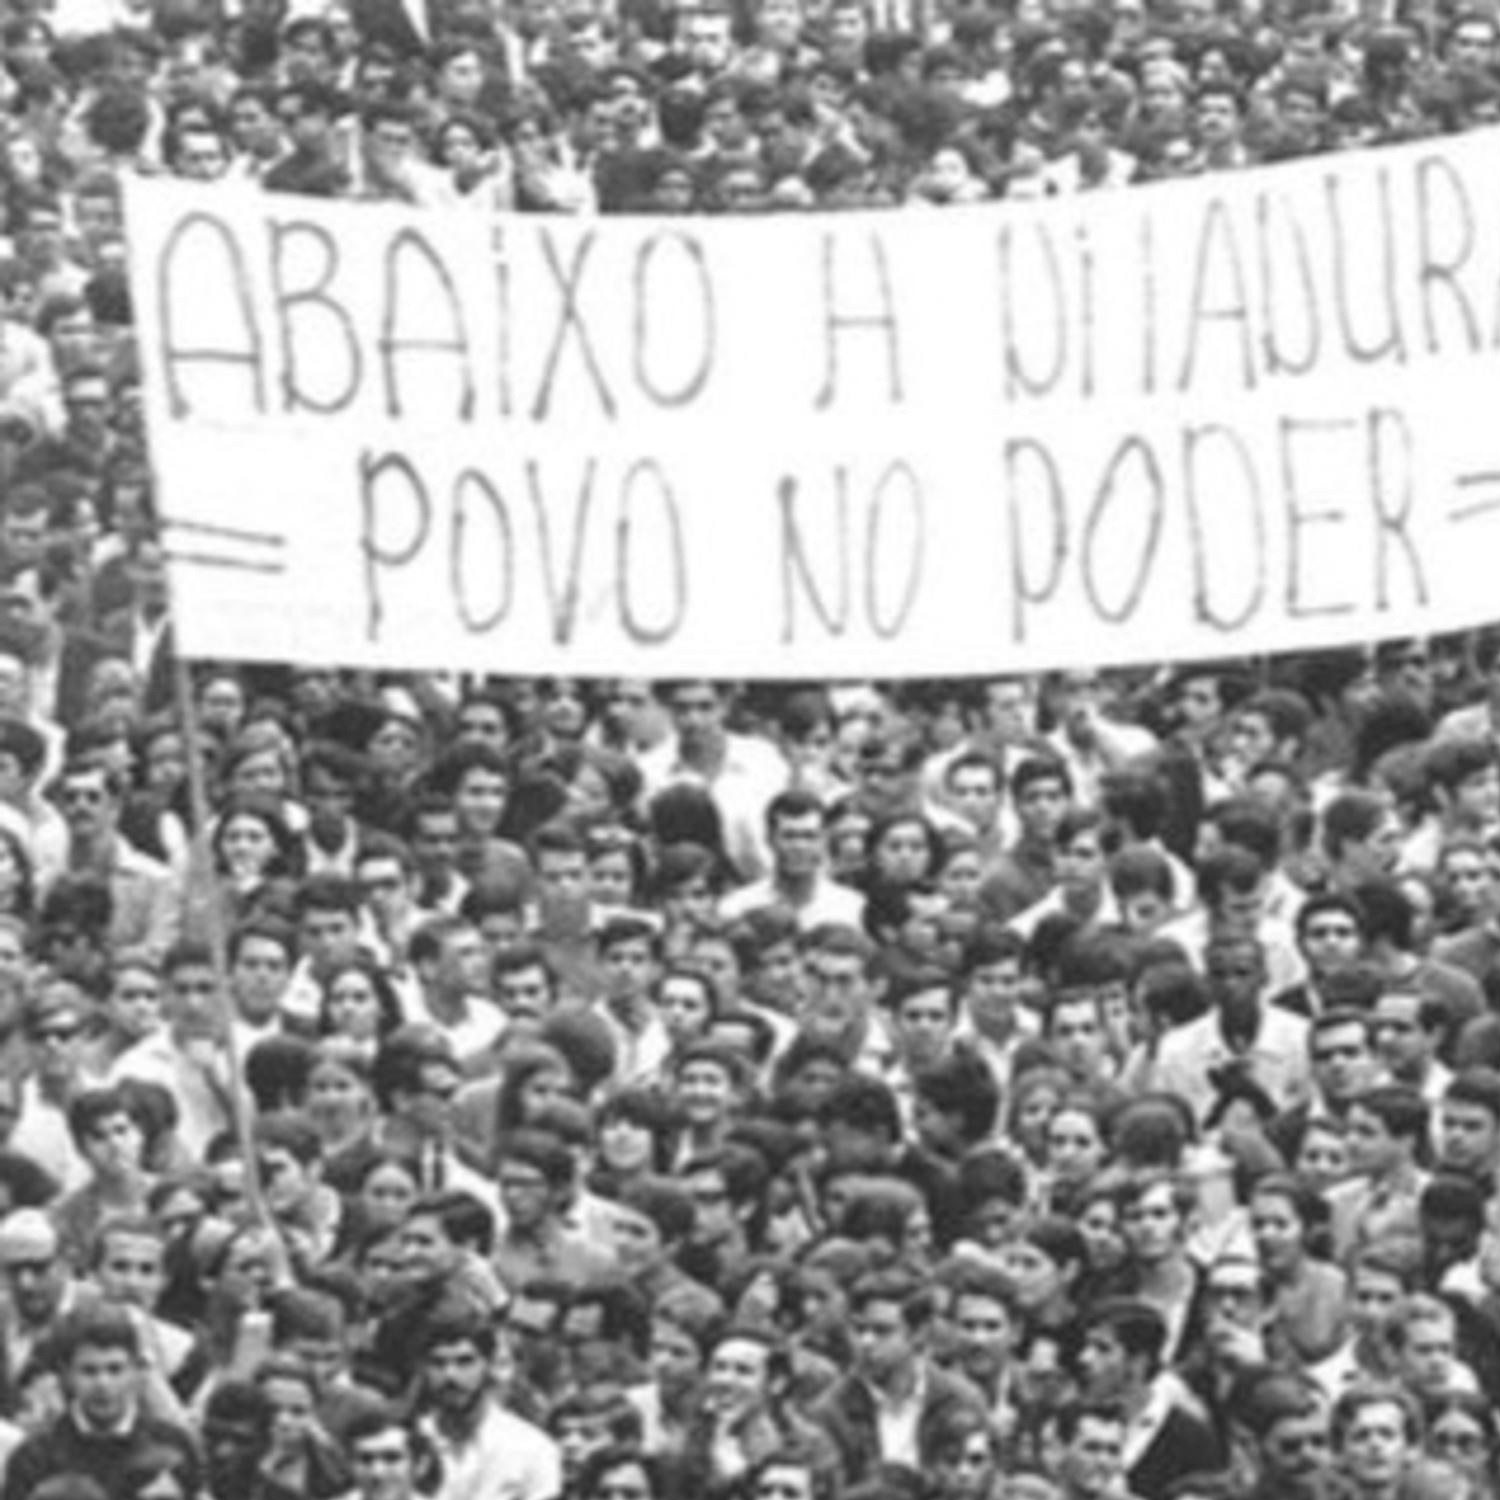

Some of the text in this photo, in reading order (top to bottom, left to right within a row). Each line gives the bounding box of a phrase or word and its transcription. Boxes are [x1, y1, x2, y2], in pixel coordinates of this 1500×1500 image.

[356, 447, 688, 647] POVO
[775, 457, 925, 646] NO
[1003, 406, 1430, 645] PODER
